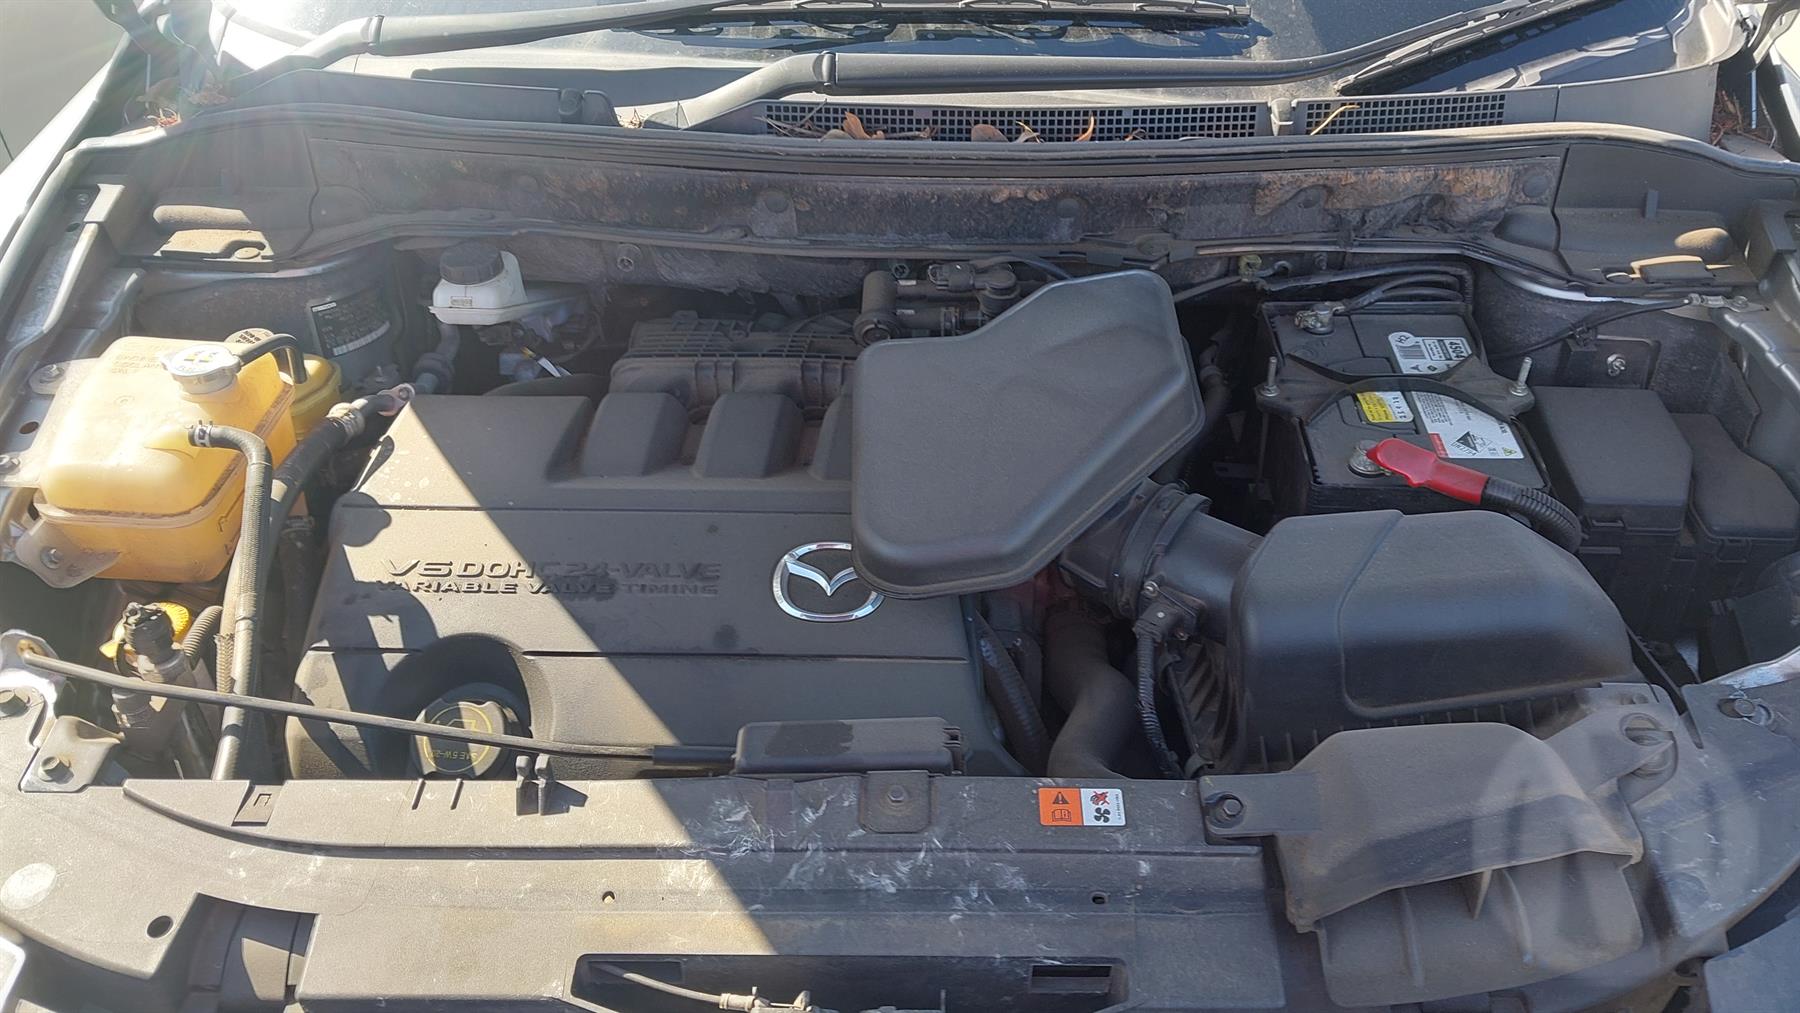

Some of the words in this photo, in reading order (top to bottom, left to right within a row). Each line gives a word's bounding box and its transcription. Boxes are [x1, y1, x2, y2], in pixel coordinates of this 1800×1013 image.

[387, 559, 453, 578] V6
[456, 559, 560, 579] DOHC
[563, 561, 721, 580] 24-VALVE
[377, 580, 518, 594] VARIABLE
[527, 581, 614, 596] VALVE
[620, 583, 719, 596] TIMING
